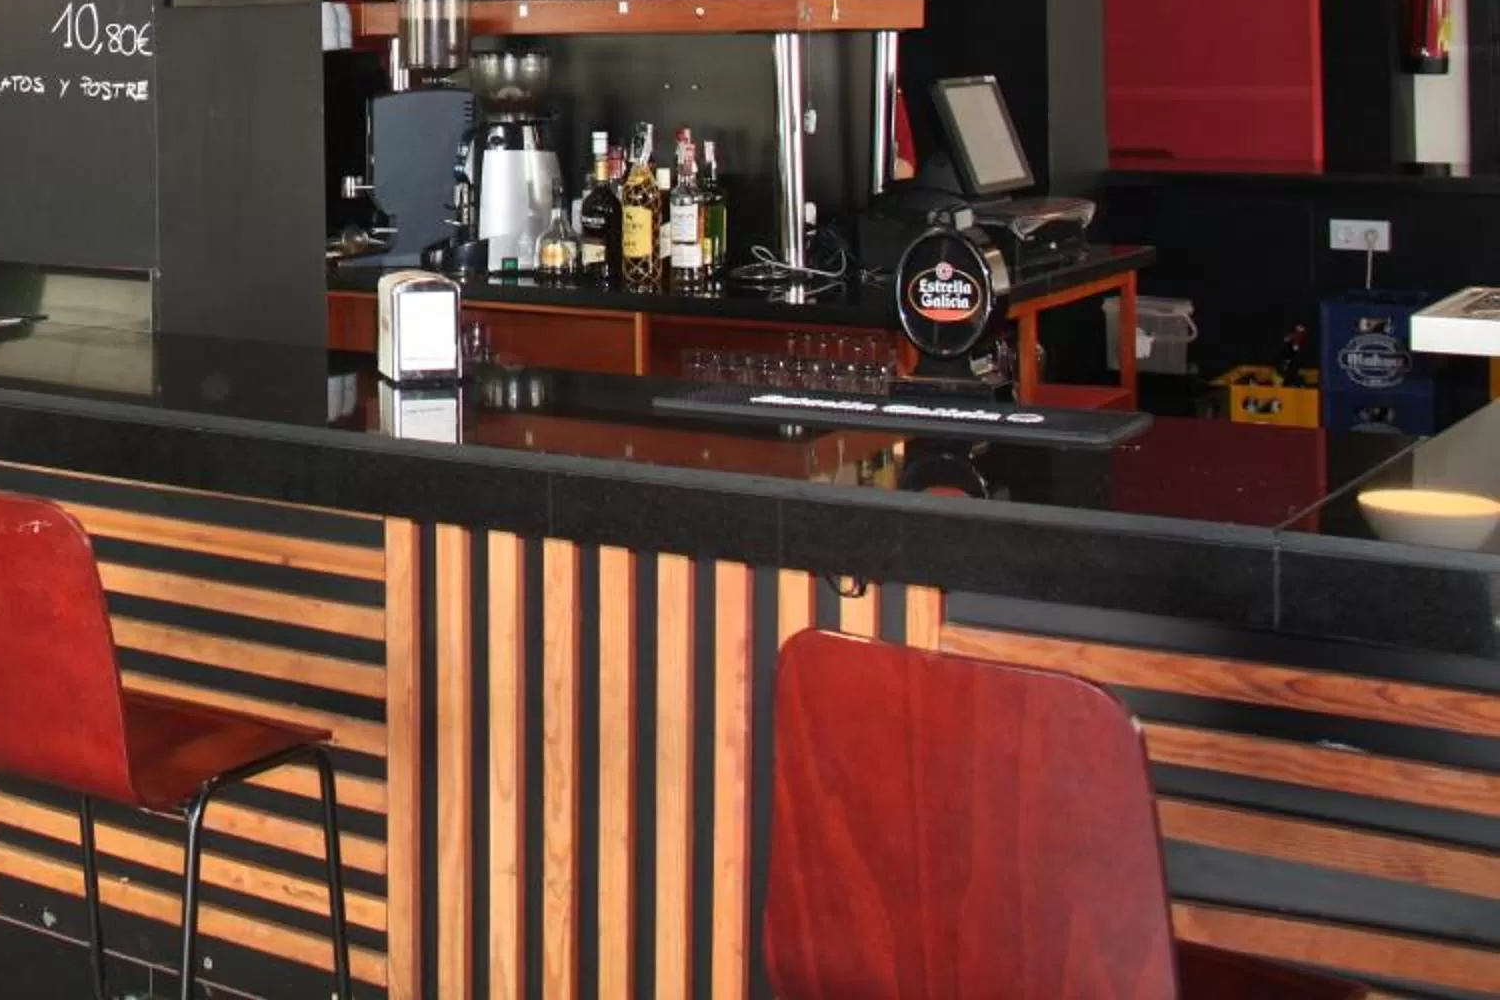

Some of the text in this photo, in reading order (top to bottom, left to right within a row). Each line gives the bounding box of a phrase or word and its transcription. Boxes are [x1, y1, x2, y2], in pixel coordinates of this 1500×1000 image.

[50, 1, 154, 57] 10,80€
[79, 74, 150, 102] POSTRE
[919, 277, 972, 296] Estrella
[920, 292, 970, 309] Galicia
